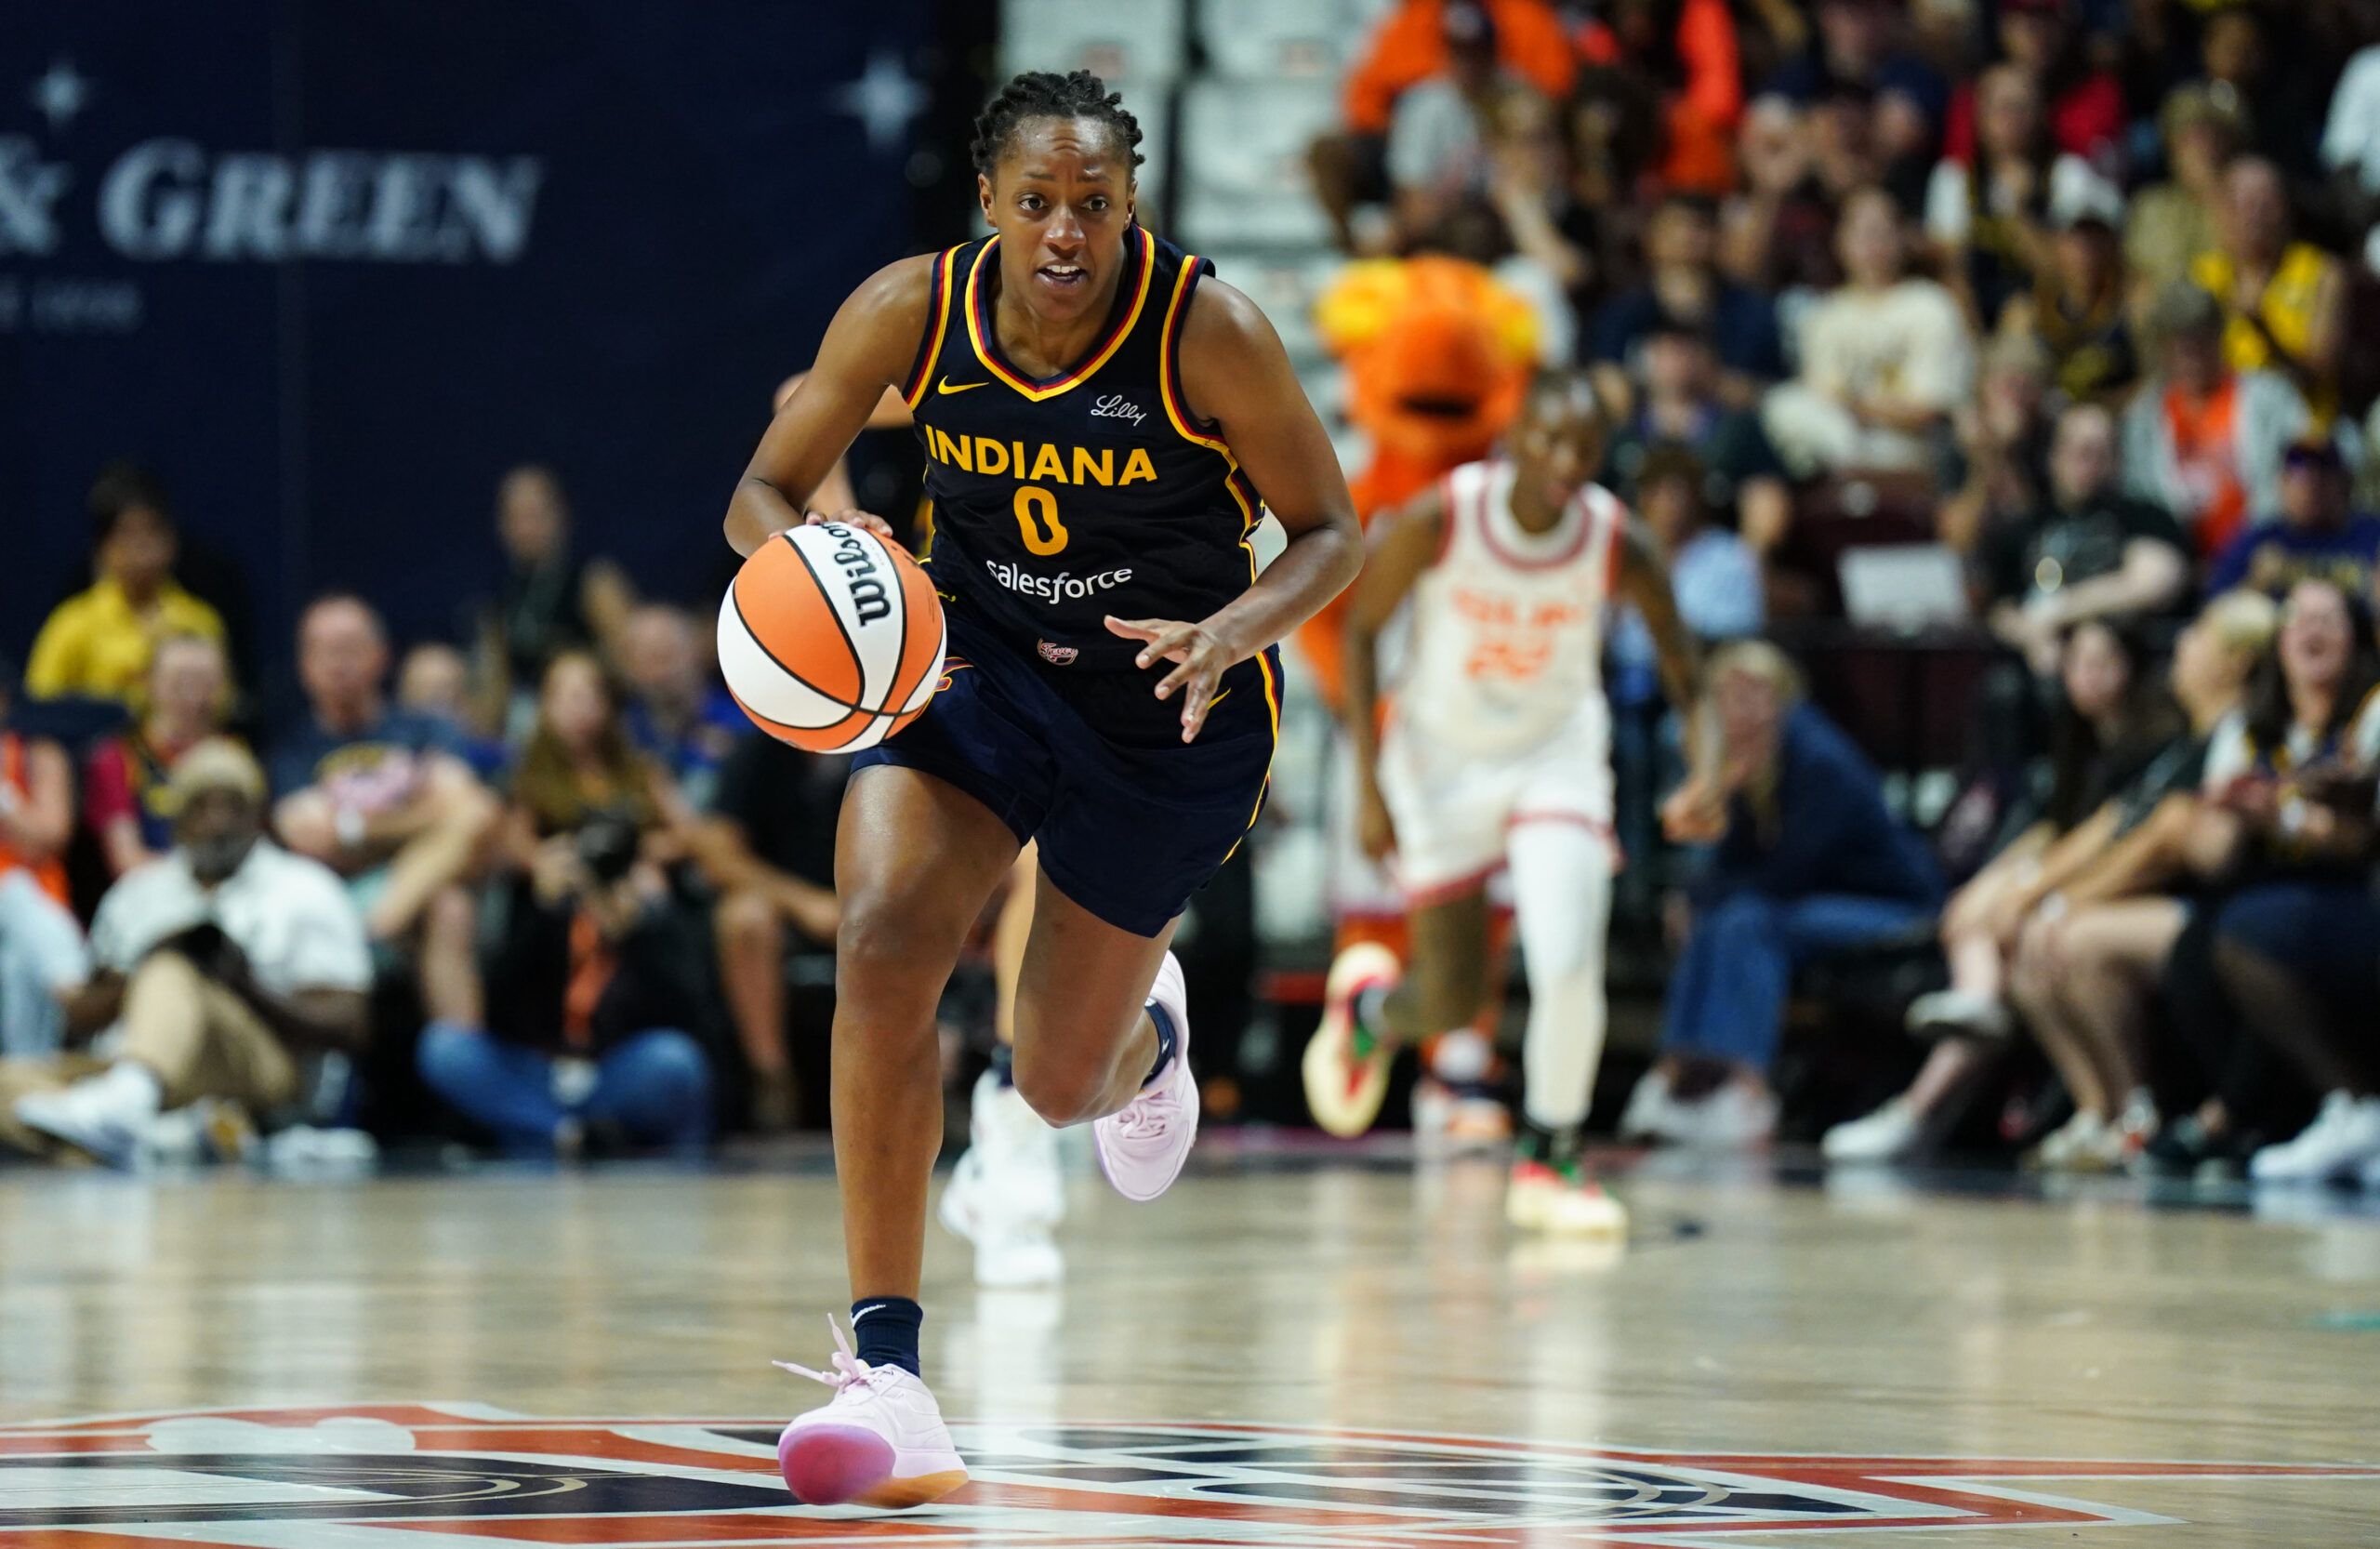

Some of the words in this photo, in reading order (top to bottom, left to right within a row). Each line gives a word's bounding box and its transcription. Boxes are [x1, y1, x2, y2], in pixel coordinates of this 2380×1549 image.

[0, 136, 67, 255] &
[100, 138, 541, 263] GREEN
[1091, 394, 1146, 427] Lilly
[926, 425, 1157, 485] INDIANA
[1013, 485, 1068, 556] 0
[986, 561, 1132, 604] salesforce
